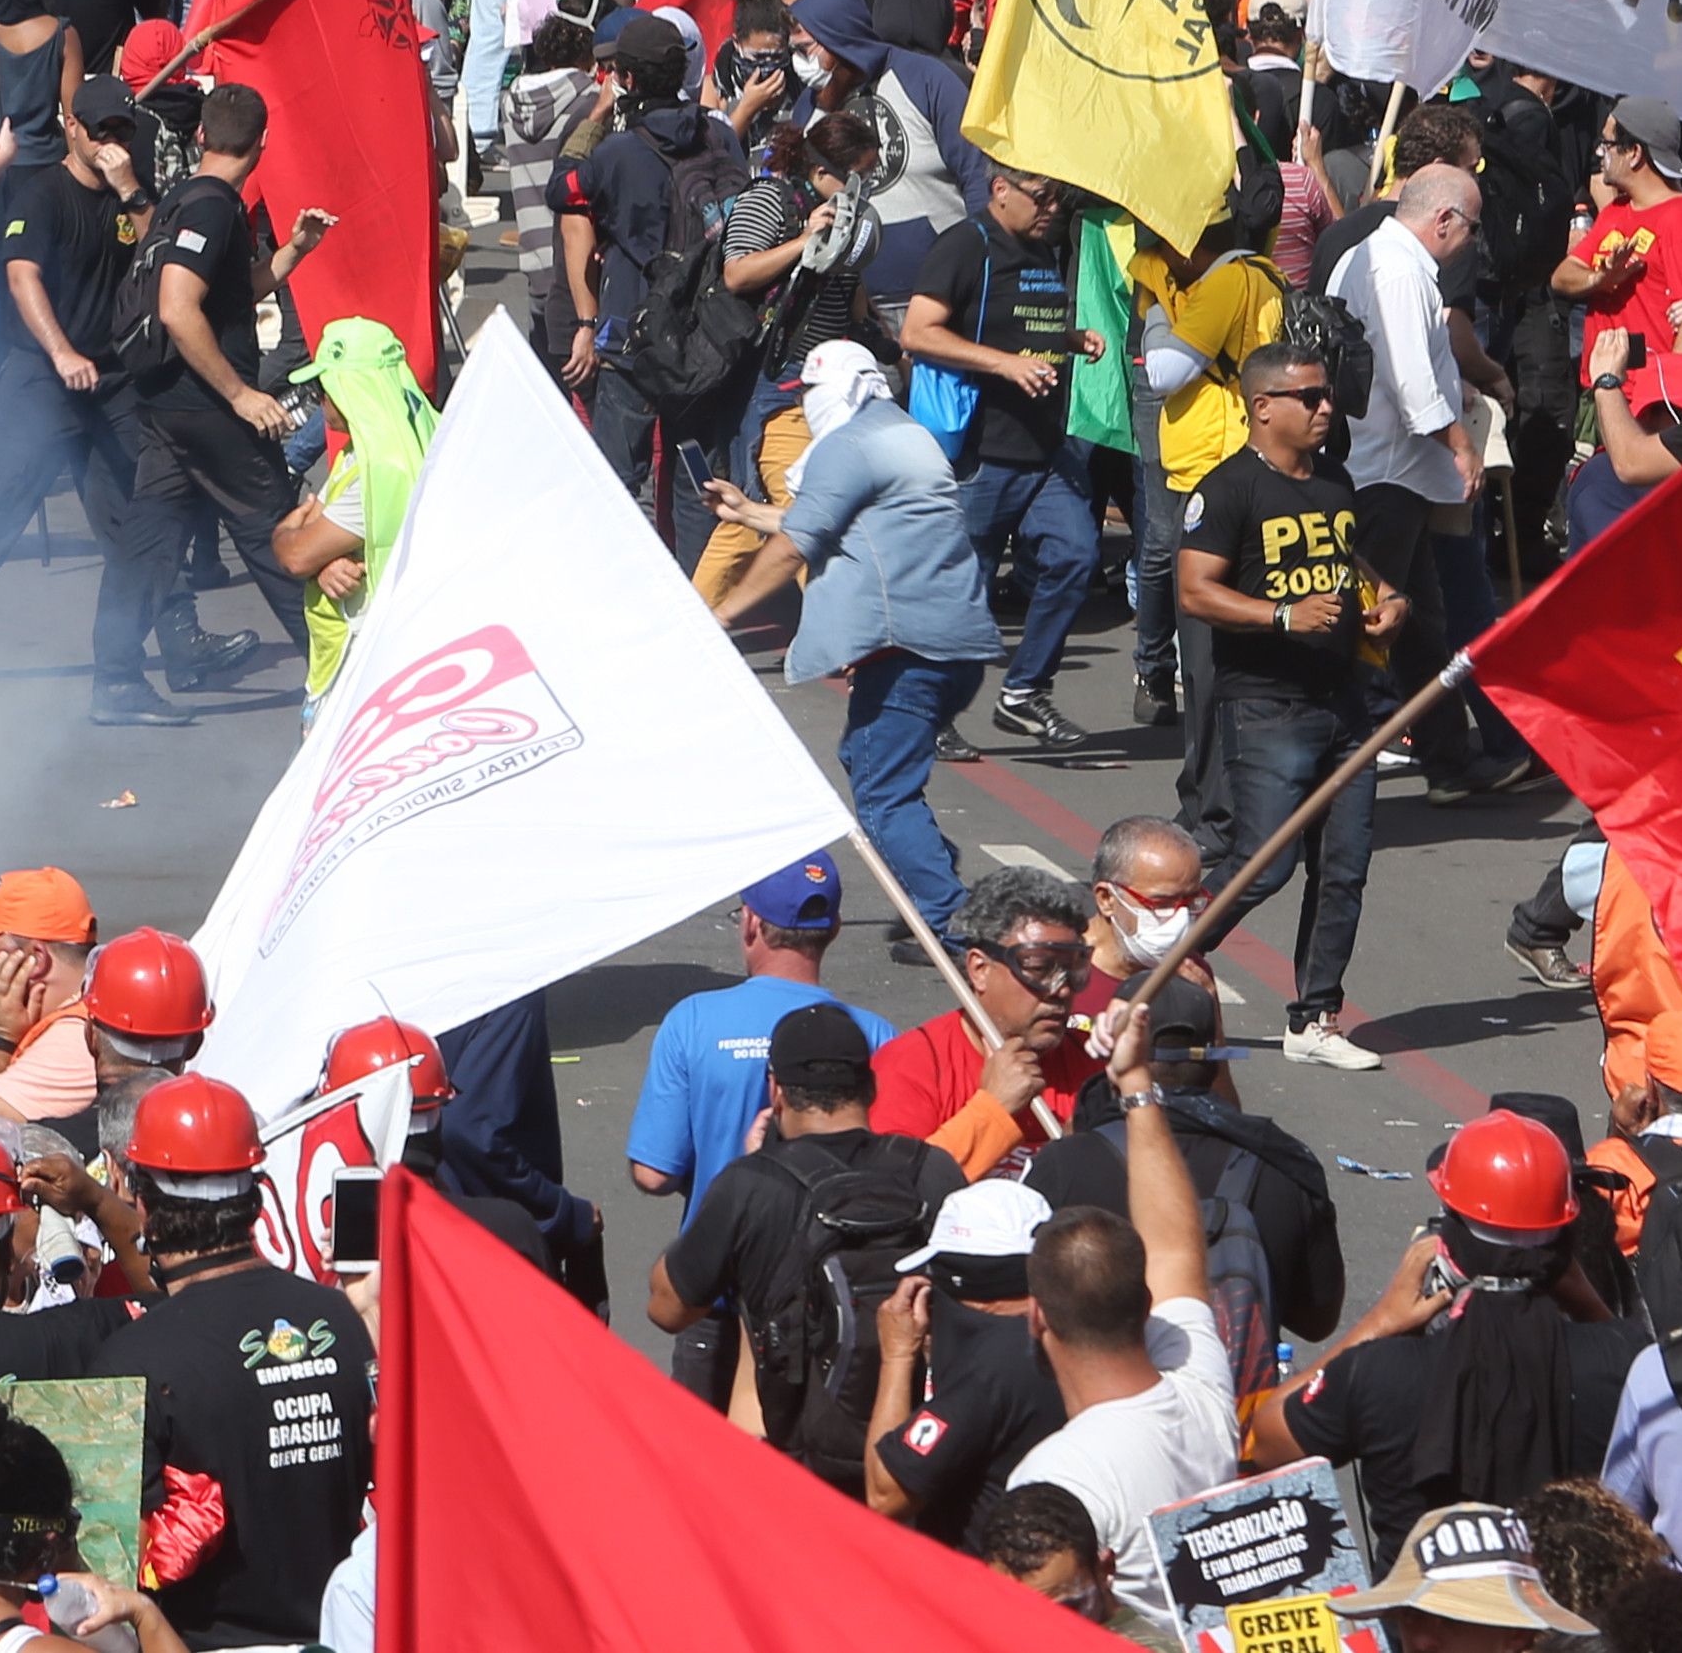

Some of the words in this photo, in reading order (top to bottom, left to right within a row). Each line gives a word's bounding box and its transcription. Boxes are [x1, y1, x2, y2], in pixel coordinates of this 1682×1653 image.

[1261, 509, 1356, 565] PEC
[255, 1356, 339, 1386] EMPREGO
[272, 1392, 334, 1422] OCUPA
[268, 1414, 343, 1448] BRASÍLIA
[268, 1447, 307, 1469] GREVE
[1183, 1499, 1308, 1560] TERCEIRIZAÇÃO
[1419, 1515, 1505, 1566] FORA
[1210, 1556, 1232, 1577] FIM
[1230, 1548, 1259, 1571] DOS
[1255, 1533, 1309, 1564] DIREITOS
[1217, 1556, 1305, 1597] TRABALHISTAS!
[1239, 1606, 1321, 1638] GREVE
